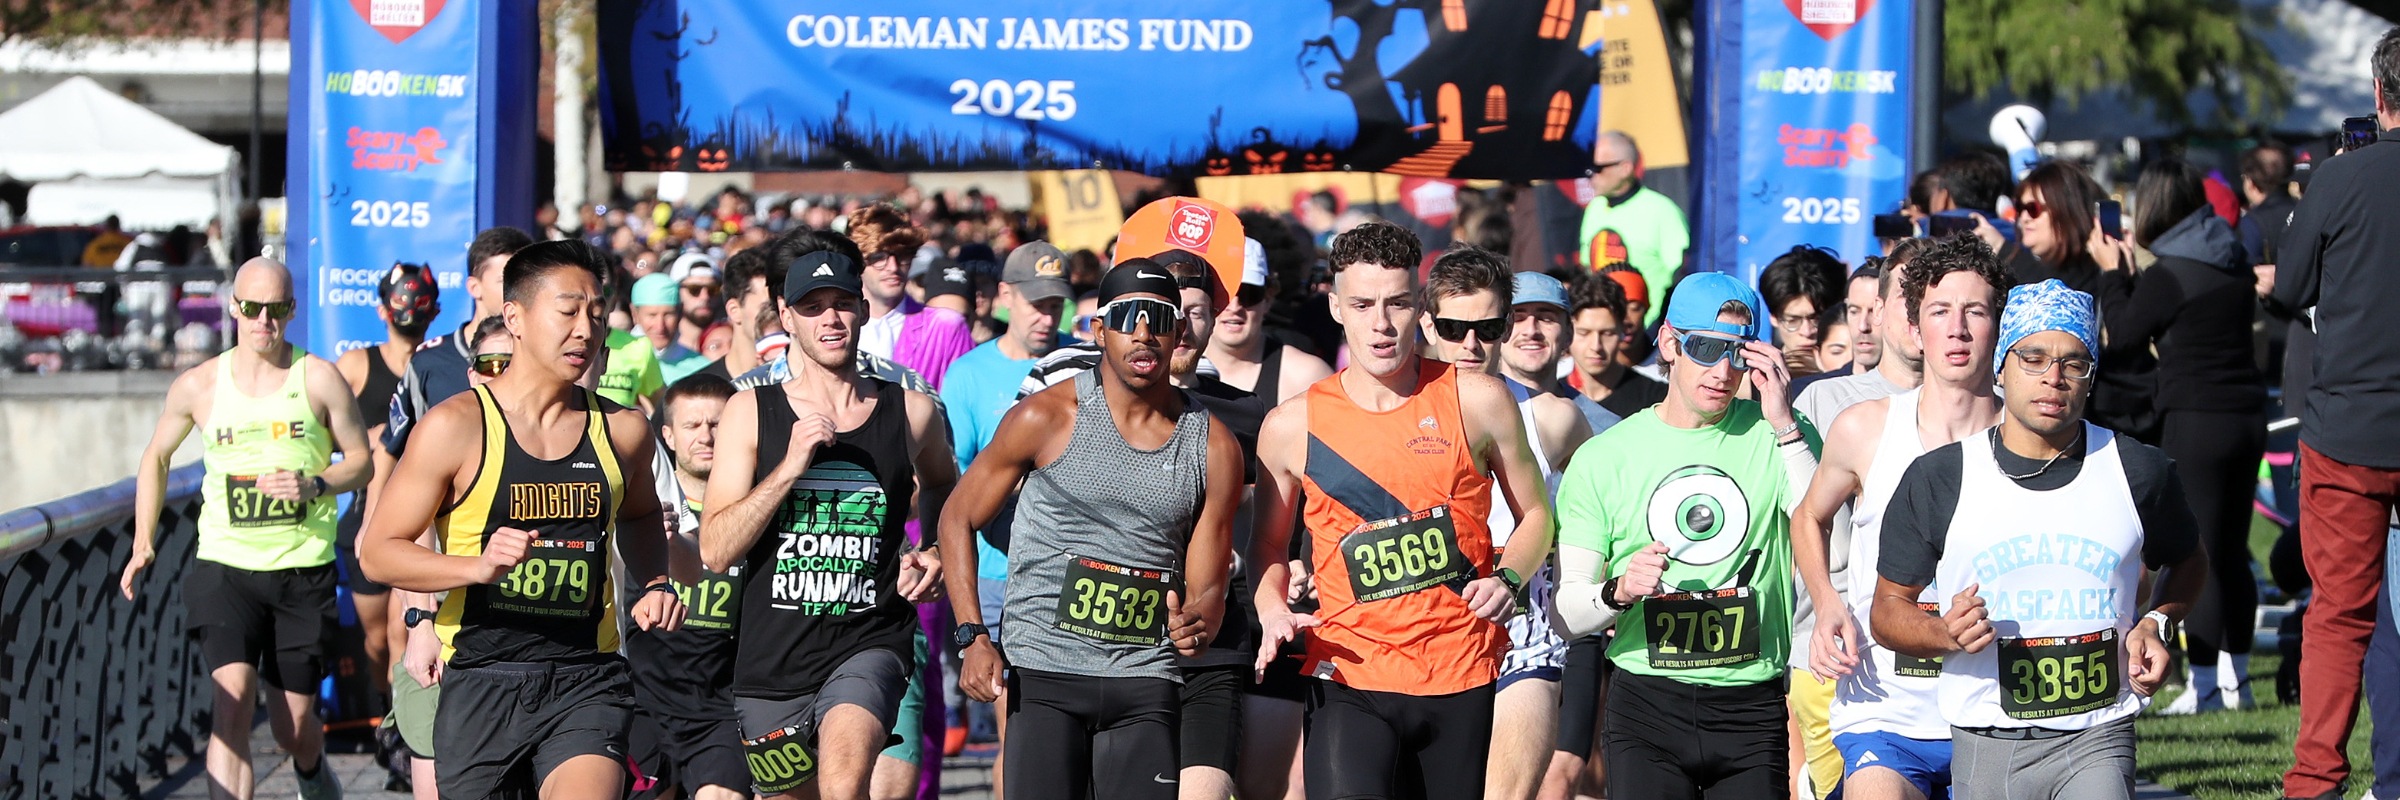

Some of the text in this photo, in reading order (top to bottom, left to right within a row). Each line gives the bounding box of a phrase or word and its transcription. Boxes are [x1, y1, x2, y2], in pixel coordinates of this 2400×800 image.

[786, 14, 1253, 52] COLEMAN JAMES FUND
[326, 69, 466, 97] HOBOOKEN5K
[1757, 67, 1897, 94] HOBOOKEN5K
[949, 79, 1077, 120] 2025
[346, 126, 406, 150] Scary
[1778, 123, 1838, 149] Scary
[352, 149, 420, 172] Scurry
[1784, 145, 1848, 169] Scurry
[350, 200, 431, 227] 2025
[1782, 197, 1861, 224] 2025
[1178, 221, 1205, 240] POP
[1034, 255, 1062, 277] Cal
[328, 288, 383, 307] GROU
[1406, 435, 1434, 448] CENTRAL
[510, 482, 601, 521] KNIGHTS
[1411, 510, 1431, 522] 2025
[566, 540, 585, 549] 2025
[776, 532, 882, 564] ZOMBIE
[1354, 527, 1449, 587] 3569
[775, 556, 877, 578] APOCALYPSE
[1079, 558, 1160, 579] HOBOOKEN5K 2025
[1972, 533, 2121, 584] GREATER
[500, 558, 589, 603] 3879
[772, 570, 877, 604] RUNNING
[1069, 577, 1160, 630] 3533
[1361, 593, 1372, 602] LIVE
[1372, 589, 1394, 600] RESULTS
[1393, 588, 1400, 596] AT
[1716, 589, 1736, 598] 2025
[1979, 588, 2119, 621] PASCACK
[1060, 621, 1071, 630] LIVE
[1071, 623, 1093, 637] RESULTS
[1093, 628, 1101, 638] AT
[1656, 606, 1745, 654] 2767
[2081, 633, 2100, 644] 2025
[1901, 667, 1912, 675] LIVE
[1912, 668, 1936, 676] RESULTS
[2011, 649, 2108, 705] 3855
[2021, 710, 2045, 718] RESULTS
[2046, 709, 2054, 717] AT
[767, 729, 785, 741] 2025
[746, 742, 813, 782] 009
